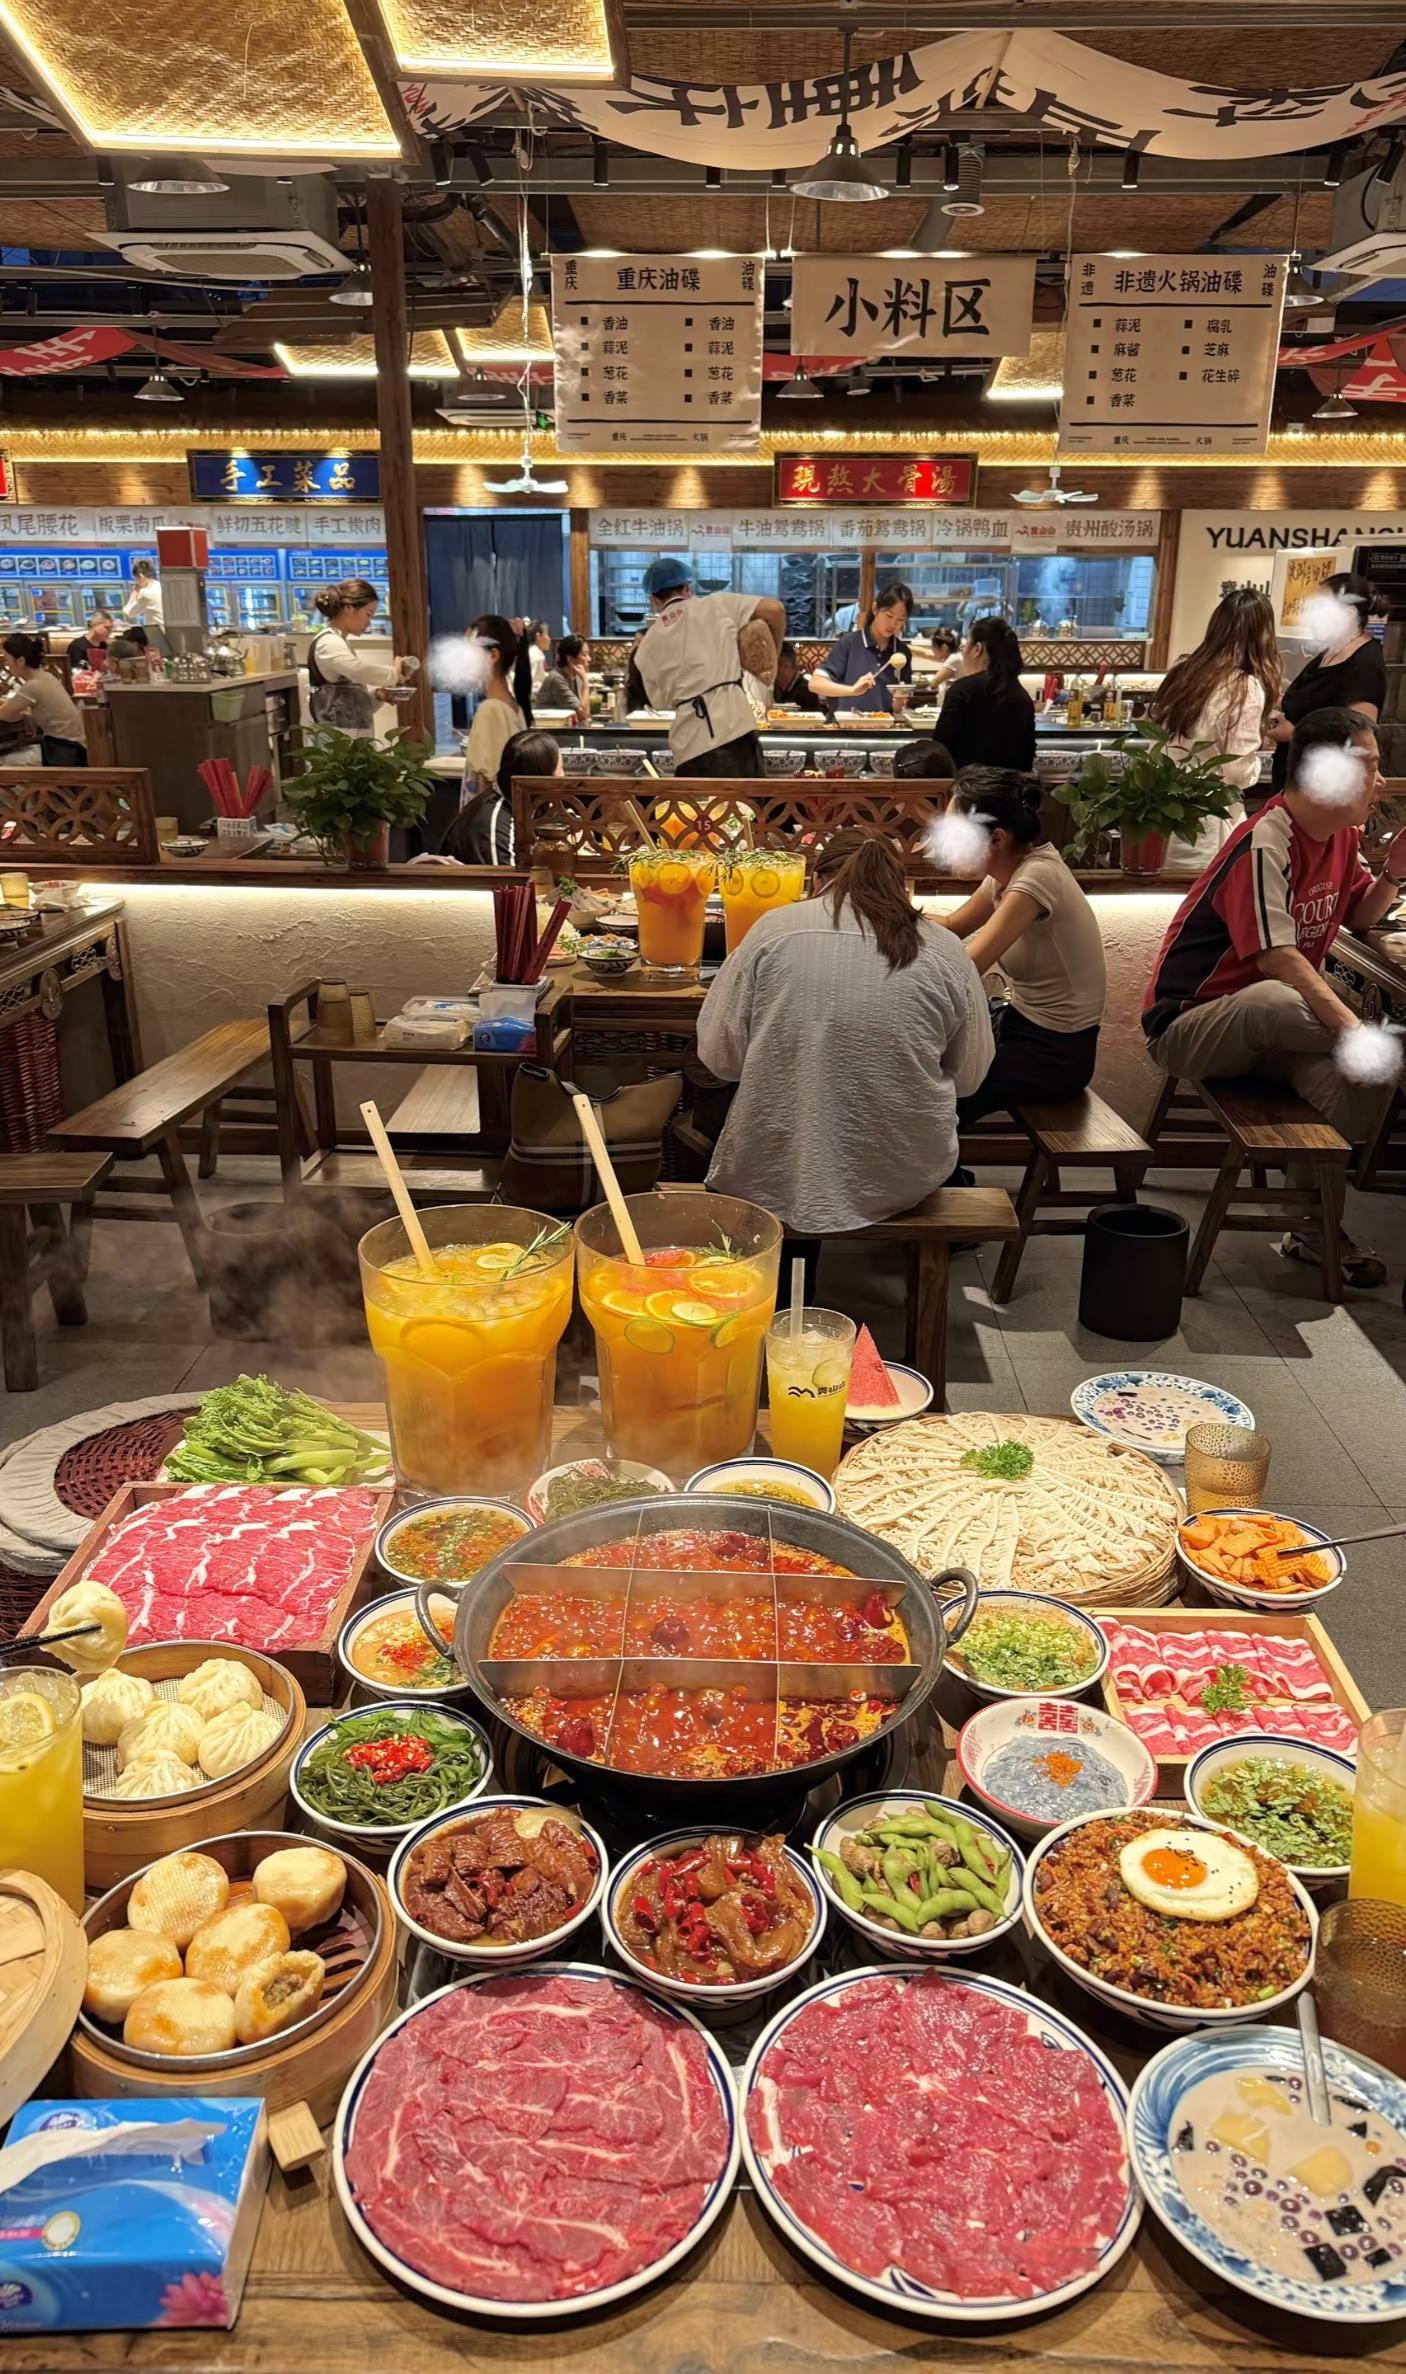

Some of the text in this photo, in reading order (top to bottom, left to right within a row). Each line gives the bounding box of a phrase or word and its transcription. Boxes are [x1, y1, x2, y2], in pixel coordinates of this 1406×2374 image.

[565, 259, 578, 290] 重庆
[616, 266, 701, 292] 重庆油碟
[741, 261, 755, 291] 油碟
[1080, 262, 1096, 296] 非遗
[1113, 269, 1243, 294] 非遗火锅油碟
[1261, 263, 1278, 297] 油碟
[824, 277, 991, 339] 小料区
[602, 316, 629, 331] 香油
[708, 316, 735, 331] 香油
[1114, 318, 1142, 333] 蒜泥
[1206, 319, 1233, 334] 腐乳
[602, 340, 629, 355] 蒜泥
[708, 340, 735, 355] 蒜泥
[1113, 342, 1141, 358] 麻酱
[1203, 342, 1230, 357] 芝麻
[602, 366, 629, 381] 葱花
[707, 366, 734, 381] 葱花
[1111, 368, 1137, 383] 葱花
[1201, 368, 1241, 383] 花生碎
[603, 390, 629, 405] 香菜
[707, 391, 734, 405] 香菜
[1109, 393, 1136, 408] 香菜
[220, 458, 356, 494] 手工菜品
[598, 517, 684, 538] 全红牛油锅
[739, 518, 825, 538] 牛油鸳鸯锅
[839, 518, 926, 538] 番茄鸳鸯锅
[935, 517, 1009, 538] 冷锅鸭血
[1065, 518, 1154, 538] 贵州酸汤锅
[697, 820, 711, 830] 15
